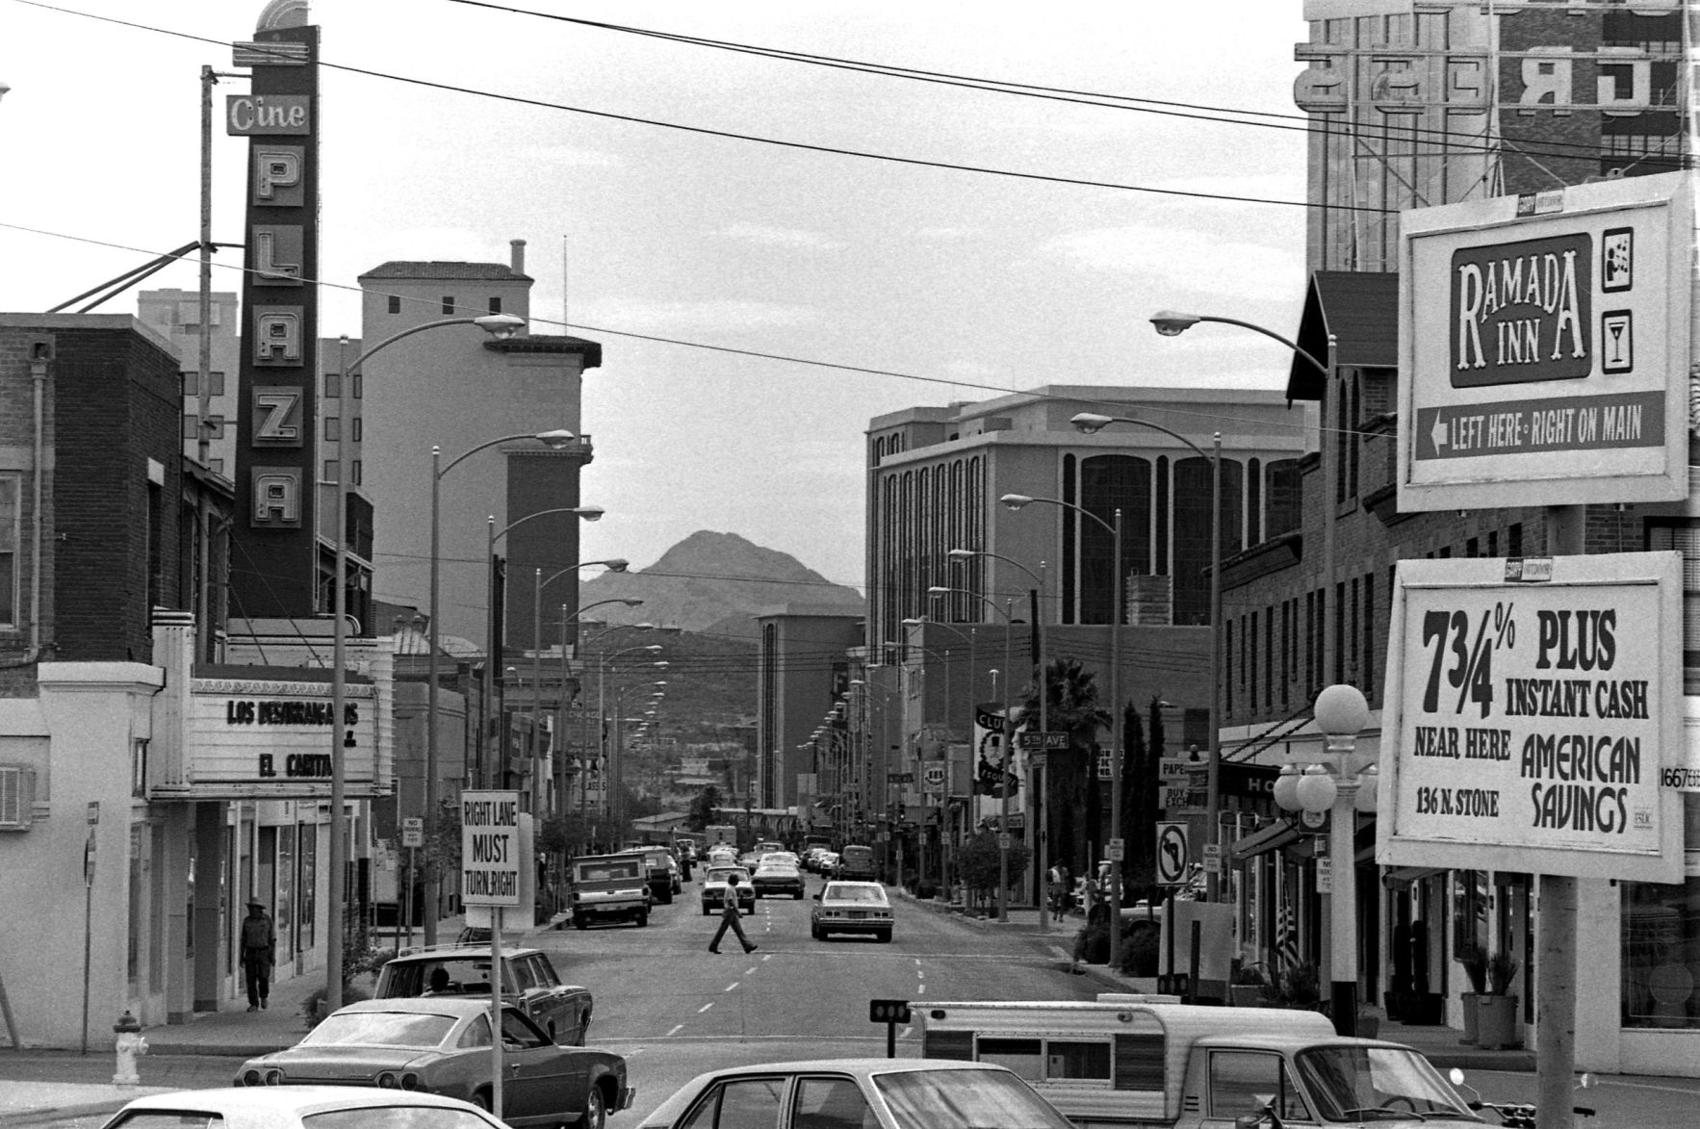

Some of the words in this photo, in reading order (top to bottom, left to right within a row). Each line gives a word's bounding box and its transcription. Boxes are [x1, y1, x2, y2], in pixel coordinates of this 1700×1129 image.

[231, 97, 306, 131] Cine
[1457, 250, 1586, 370] RAMADA
[256, 152, 301, 523] PLAZA
[1497, 318, 1540, 365] INN
[1452, 415, 1484, 450] LEFT
[1488, 412, 1523, 446] HERE
[1531, 408, 1575, 445] RIGHT
[1578, 407, 1597, 443] ON
[1602, 404, 1642, 440] MAIN
[1536, 608, 1616, 671] PLUS
[227, 700, 255, 725] LOS
[1505, 678, 1591, 718] INSTANT
[1595, 680, 1650, 719] CASH
[979, 714, 1006, 730] CLU
[1046, 735, 1066, 746] AVE
[1414, 726, 1461, 760] NEAR
[1465, 728, 1511, 761] HERE
[259, 753, 277, 777] EL
[1162, 763, 1186, 775] PAPE
[1520, 733, 1640, 784] AMERICAN
[464, 801, 491, 826] RIGHT
[493, 801, 517, 826] LANE
[1416, 786, 1438, 814] 136
[1441, 788, 1454, 815] N.
[1455, 788, 1499, 817] STONE
[1531, 782, 1628, 834] SAVINGS
[472, 834, 509, 863] MUST
[464, 870, 490, 895] TURN
[491, 870, 517, 896] RIGHT
